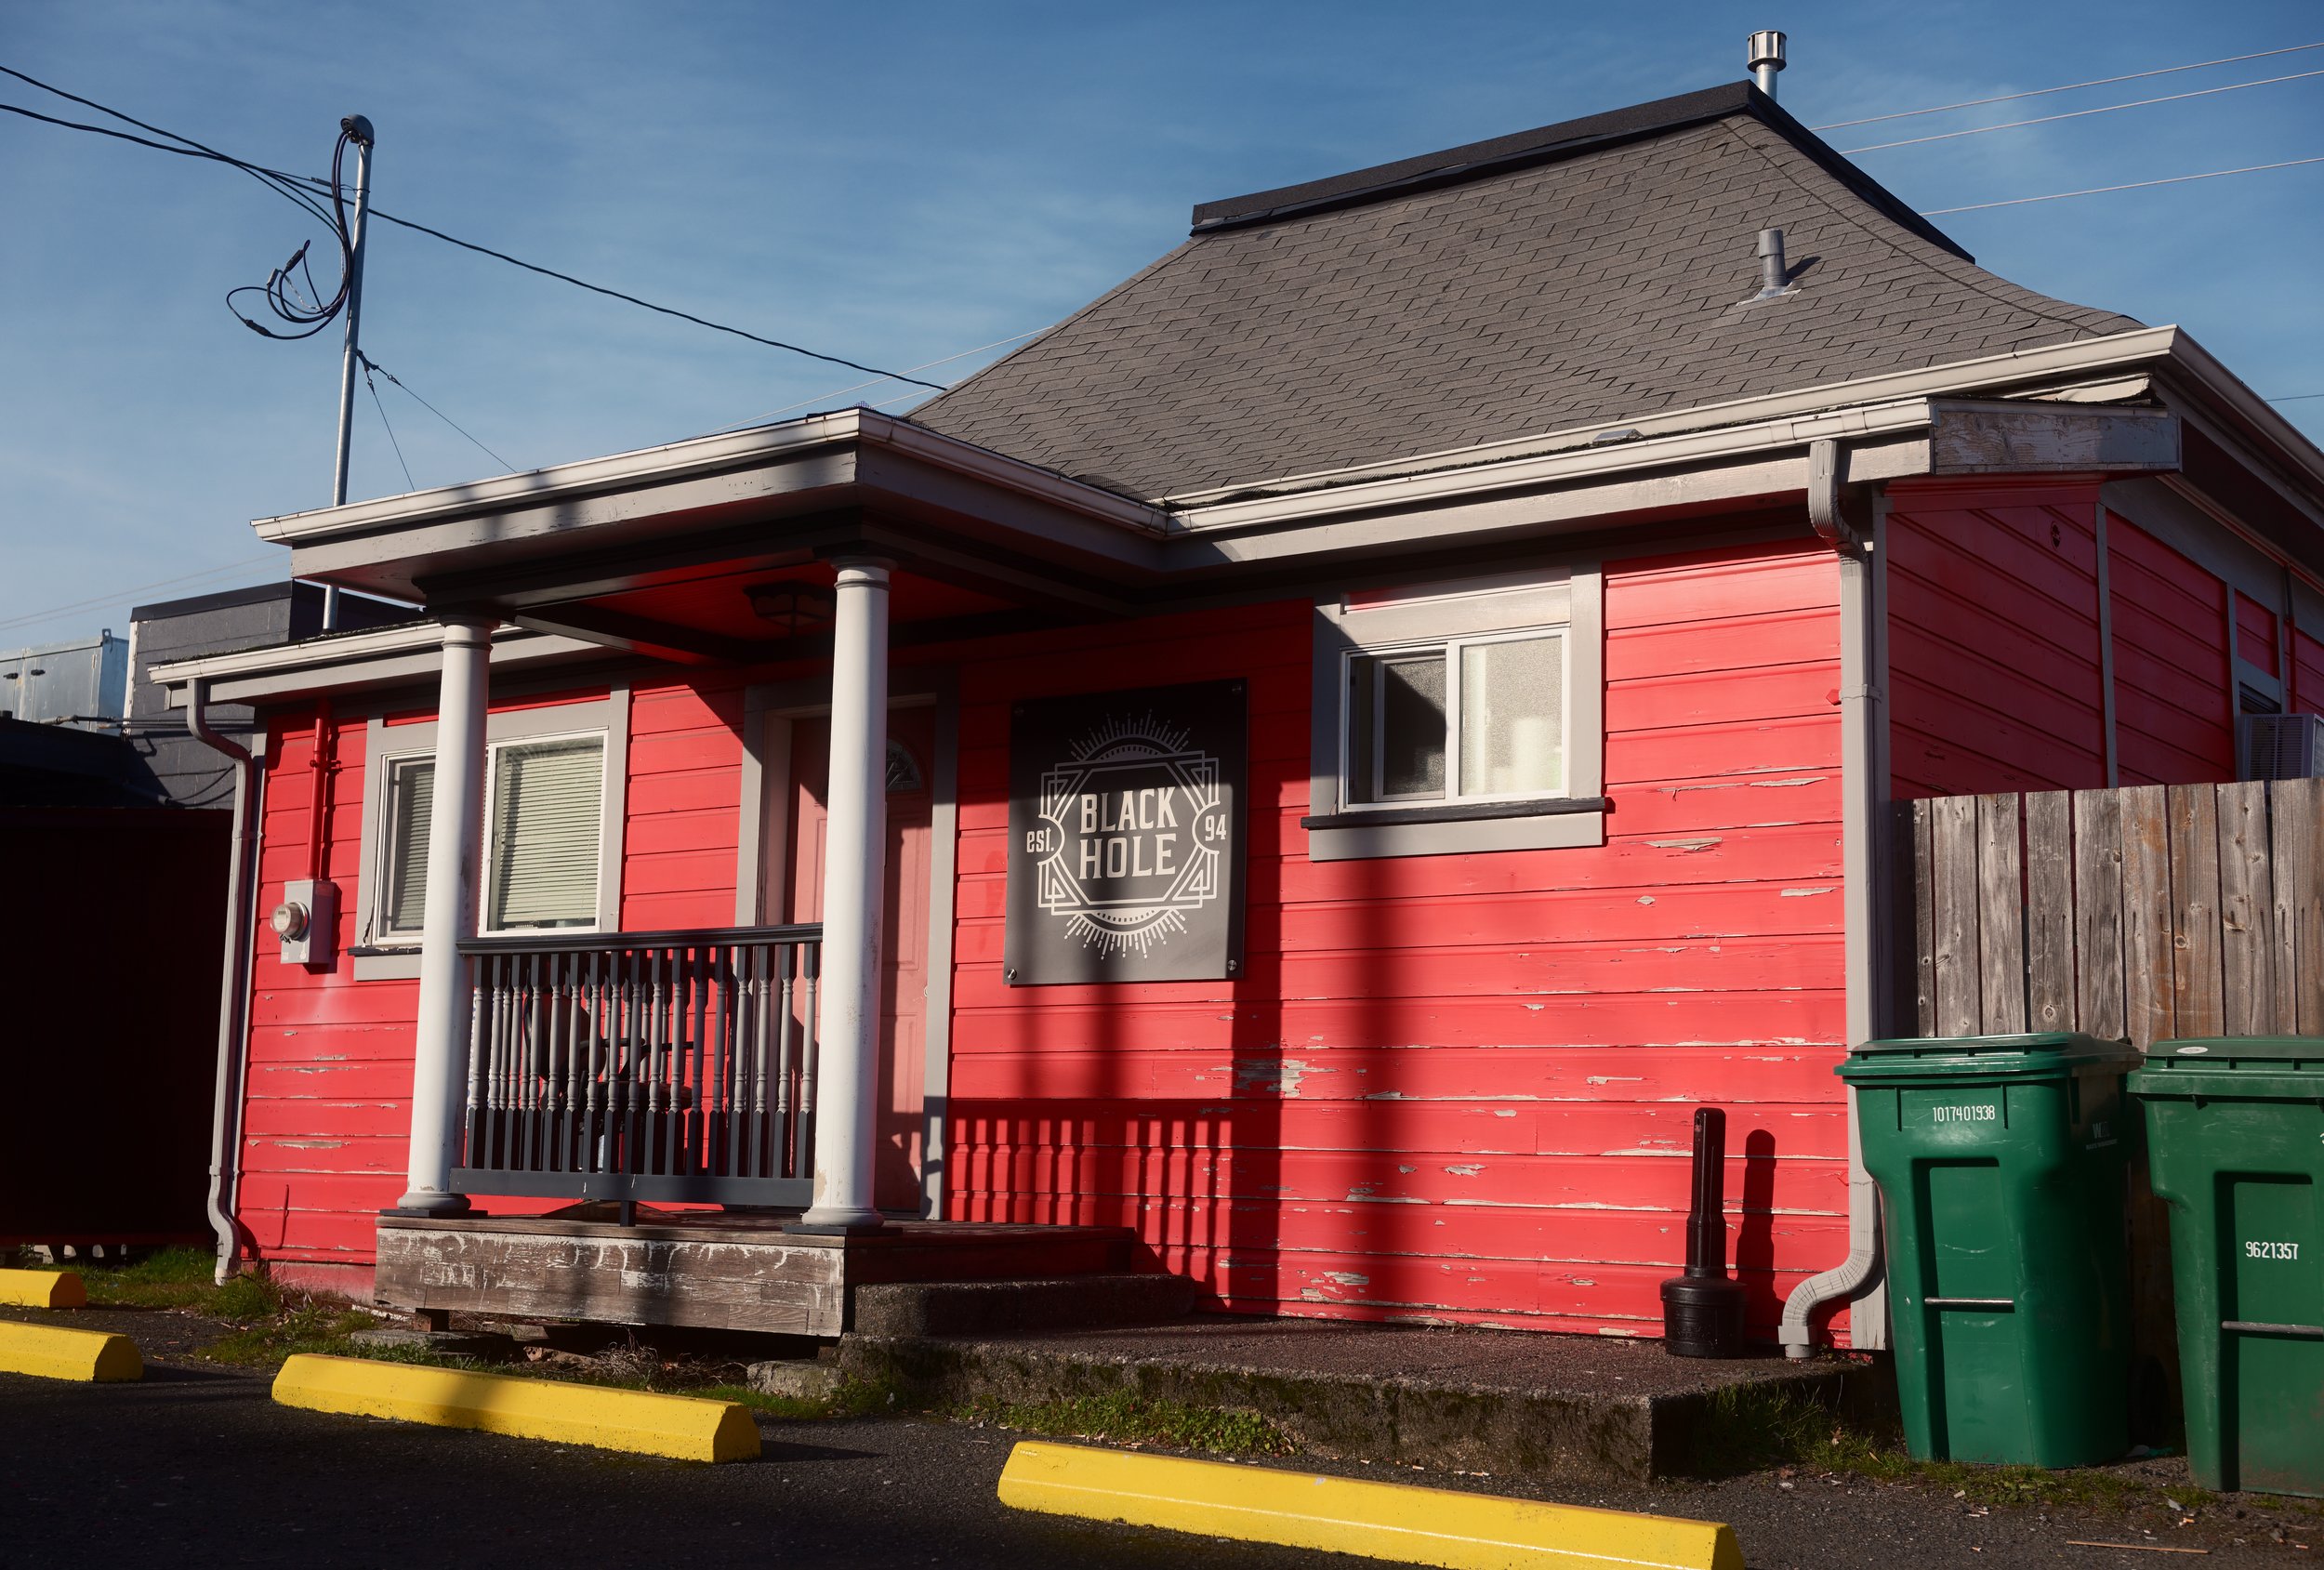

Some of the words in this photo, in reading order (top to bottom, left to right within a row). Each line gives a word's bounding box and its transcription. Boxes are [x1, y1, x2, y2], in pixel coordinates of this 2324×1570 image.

[1079, 786, 1178, 834] BLACK
[1026, 826, 1054, 852] est.
[1205, 814, 1226, 841] 94
[1078, 833, 1177, 879] HOLE
[1933, 1105, 1995, 1122] 1017401938
[2245, 1241, 2299, 1260] 9621357
